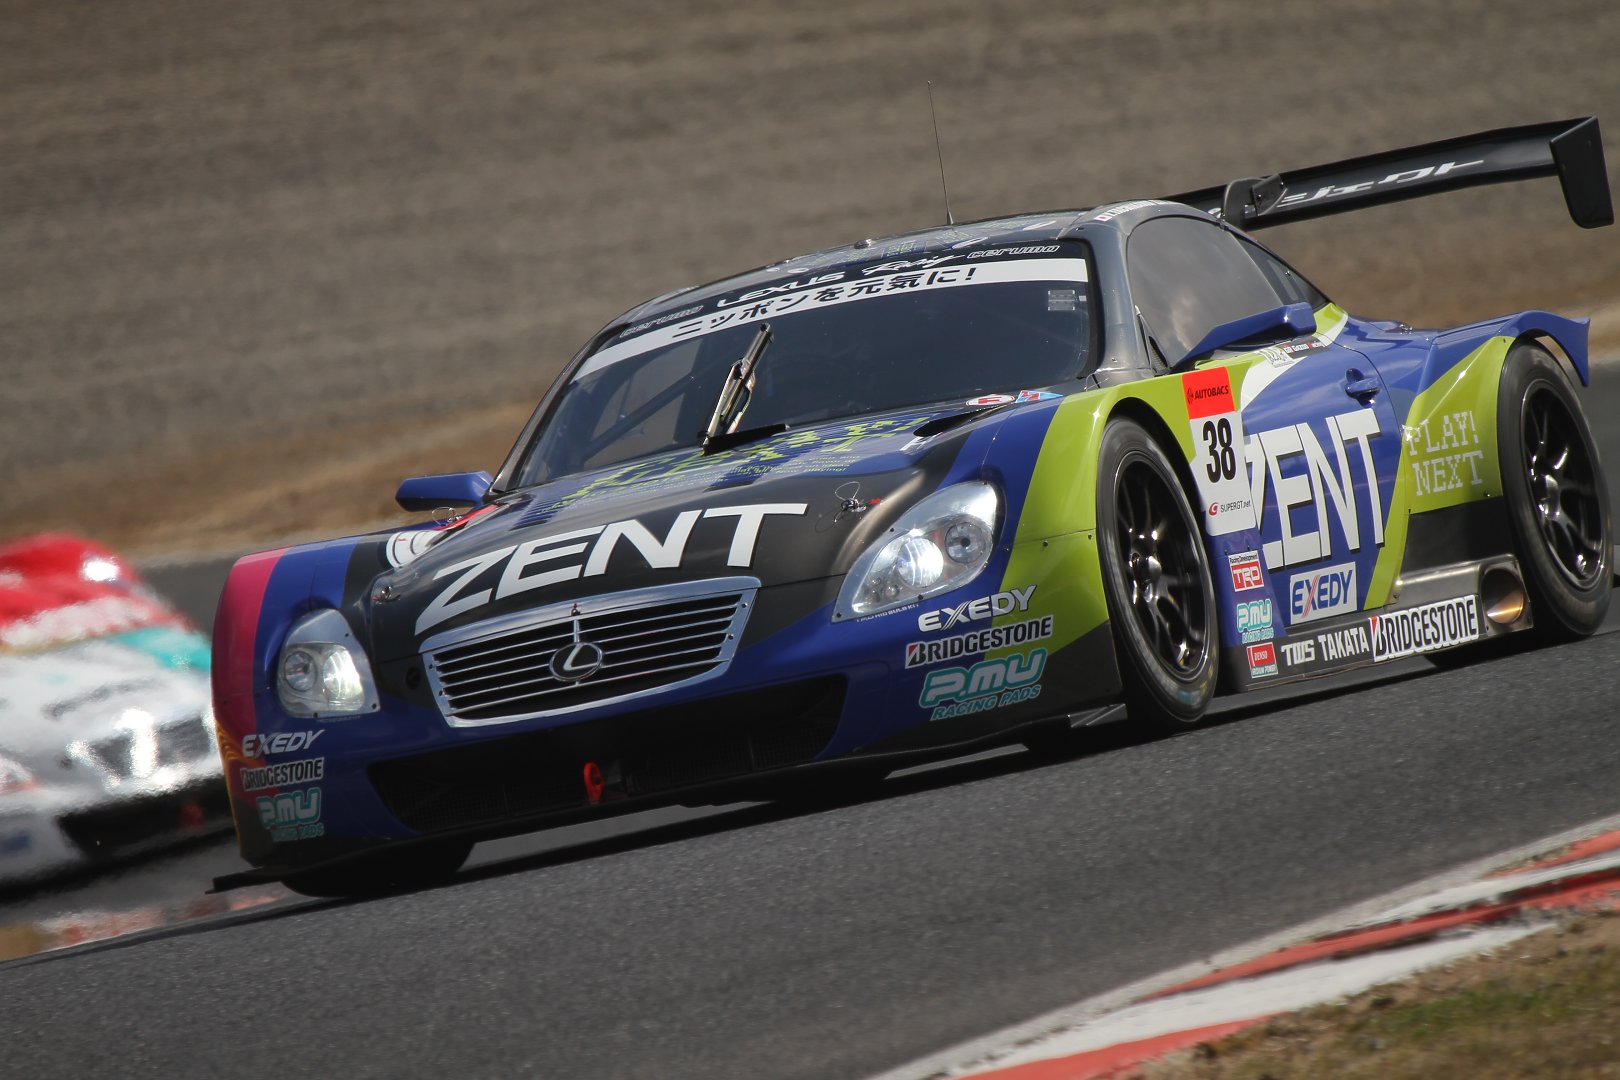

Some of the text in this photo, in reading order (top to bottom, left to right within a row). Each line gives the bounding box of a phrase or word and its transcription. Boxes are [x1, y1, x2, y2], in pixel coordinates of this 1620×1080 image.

[966, 245, 1061, 260] cerumo
[717, 271, 846, 308] LEXUS
[1194, 385, 1230, 400] AUTOBACS
[1202, 417, 1237, 484] 38
[1402, 410, 1479, 457] PLAY!
[1244, 408, 1385, 570] ZENT
[1411, 450, 1484, 497] NEXT
[414, 503, 809, 637] ZENT
[1233, 565, 1261, 589] TRD
[917, 584, 1037, 633] EXEDY
[1291, 569, 1354, 619] EXEDY
[906, 615, 1054, 668] BRIDGESTONE
[1318, 626, 1370, 662] TAKATA
[1370, 597, 1479, 660] BRIDGESTONE
[1253, 650, 1268, 661] DENSO
[930, 685, 1042, 721] RACING PADS
[241, 729, 325, 759] EXEDY
[240, 757, 325, 791] BRIDGESTONE
